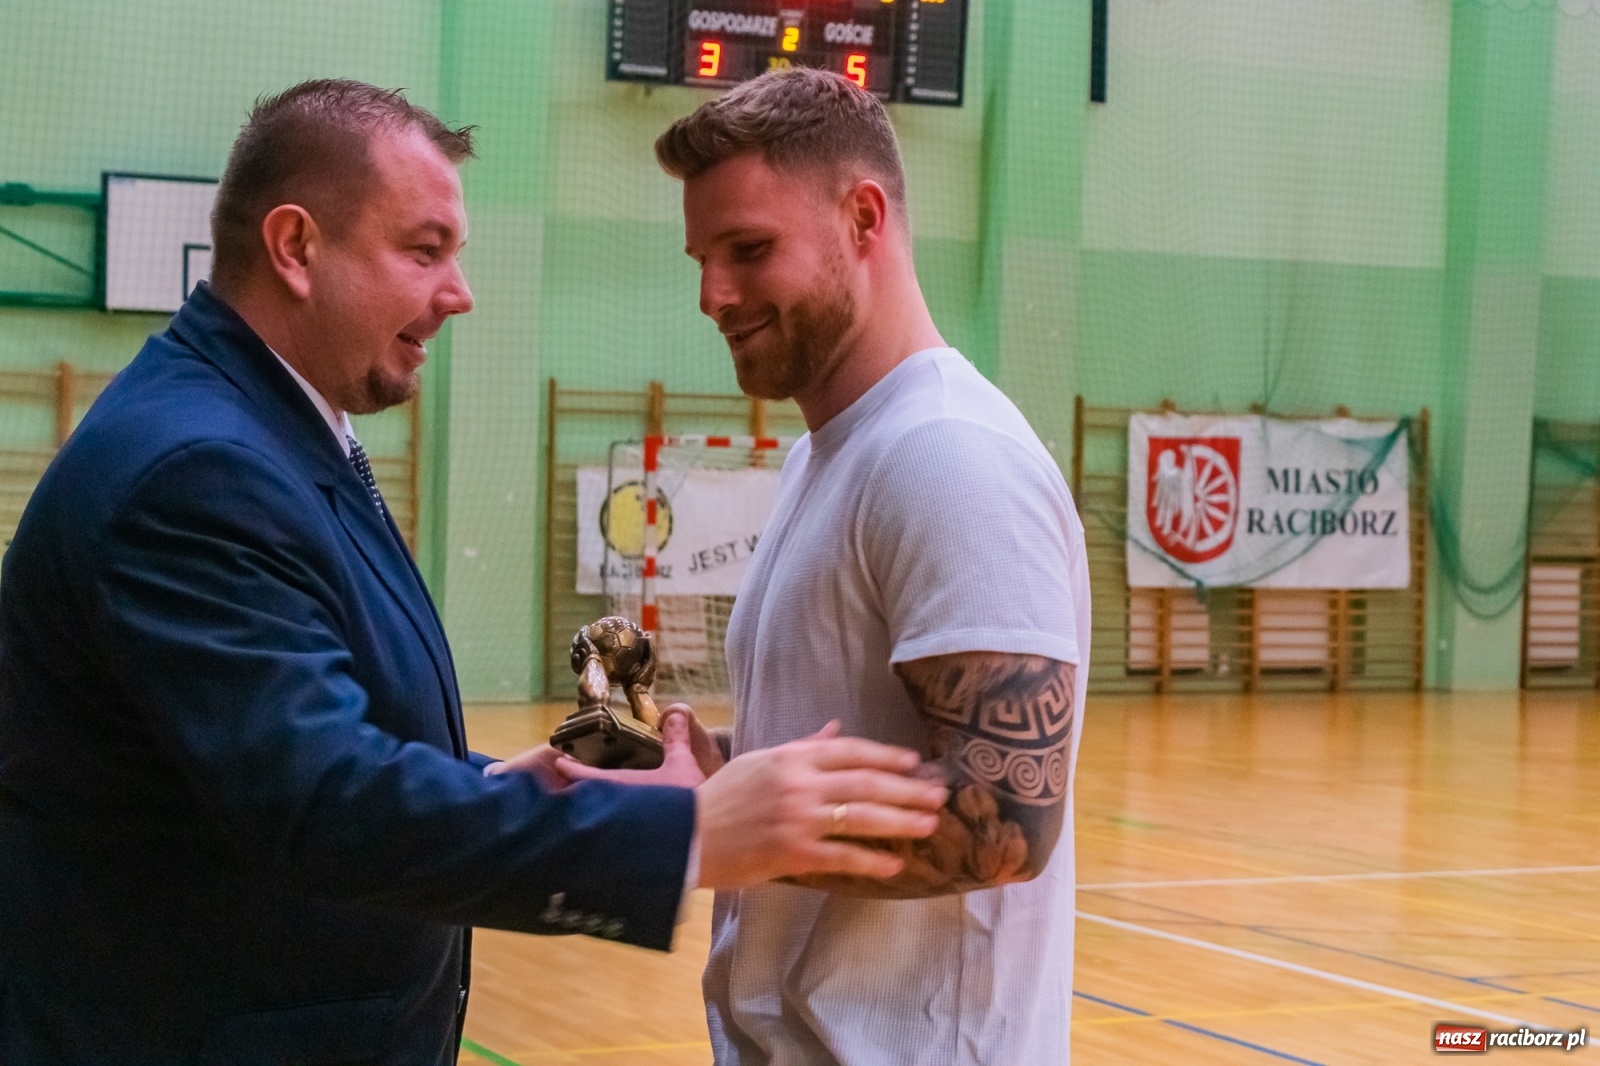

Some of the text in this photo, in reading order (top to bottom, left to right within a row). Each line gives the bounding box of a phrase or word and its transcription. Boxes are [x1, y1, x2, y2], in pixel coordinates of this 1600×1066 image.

[688, 10, 778, 36] GOSPODARZE
[782, 27, 799, 51] 2
[700, 42, 721, 77] 3
[846, 55, 867, 88] 5
[1265, 466, 1379, 495] MIASTO
[688, 539, 739, 573] JEST
